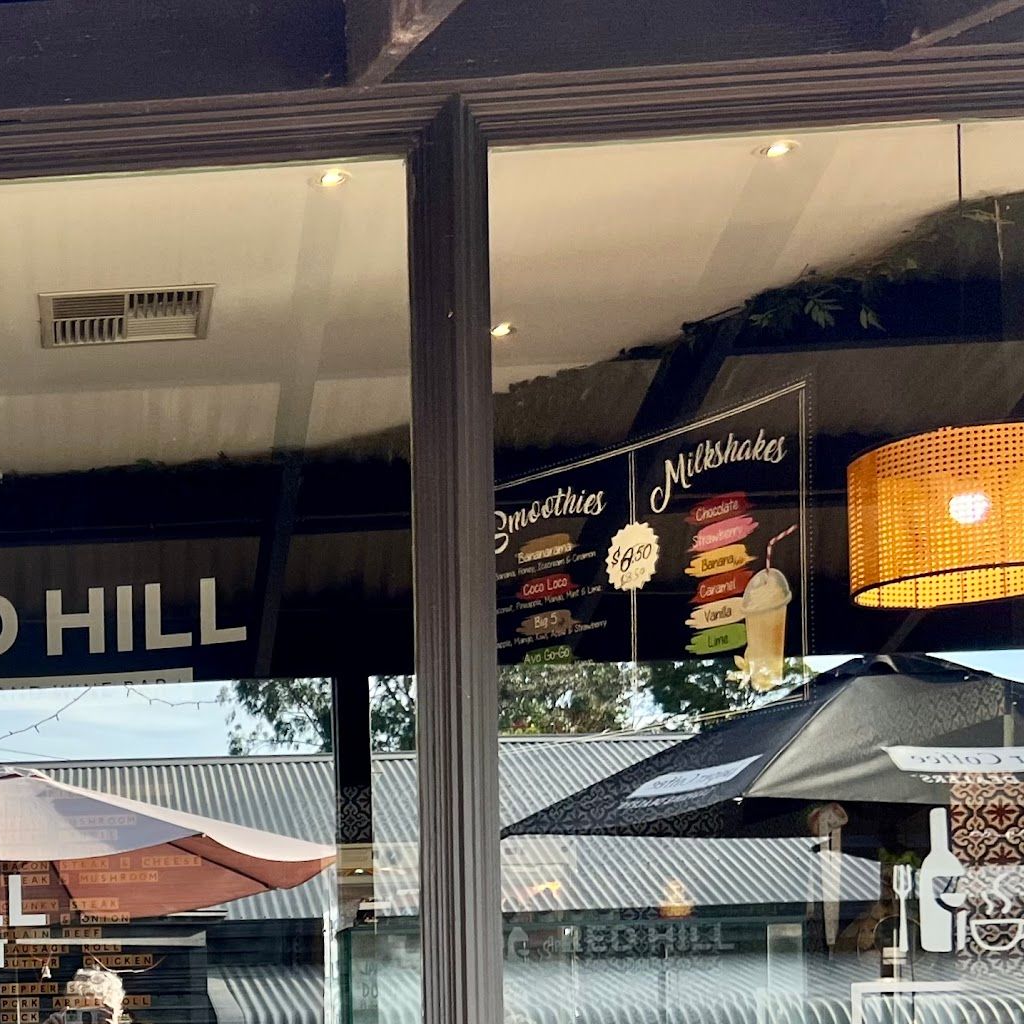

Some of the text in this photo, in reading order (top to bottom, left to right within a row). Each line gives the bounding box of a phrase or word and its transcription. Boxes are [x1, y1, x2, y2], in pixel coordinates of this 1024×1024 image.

[650, 428, 788, 514] Milkshakes
[695, 499, 739, 521] Chocolate
[692, 526, 743, 548] Strawberry
[522, 577, 568, 596] Coco Loco
[699, 580, 736, 598] Caramel
[45, 577, 247, 656] HILL
[534, 612, 558, 629] Big 5
[704, 606, 732, 622] Vanilla
[707, 634, 728, 648] Lime
[523, 645, 570, 666] Avo Go-Go
[61, 859, 108, 870] STEAK
[143, 855, 201, 867] CHEESE
[80, 872, 158, 883] MUSHROOM
[72, 899, 118, 910] STEAK
[81, 913, 130, 924] ONION
[3, 928, 101, 939] PLAIN BEEF
[83, 942, 120, 952] ROLL
[4, 955, 152, 969] BUTTER CHICKEN
[1, 984, 57, 994] PEPPER
[2, 999, 38, 1009] PORK
[114, 996, 149, 1006] OLL
[1, 1013, 38, 1023] DUCK
